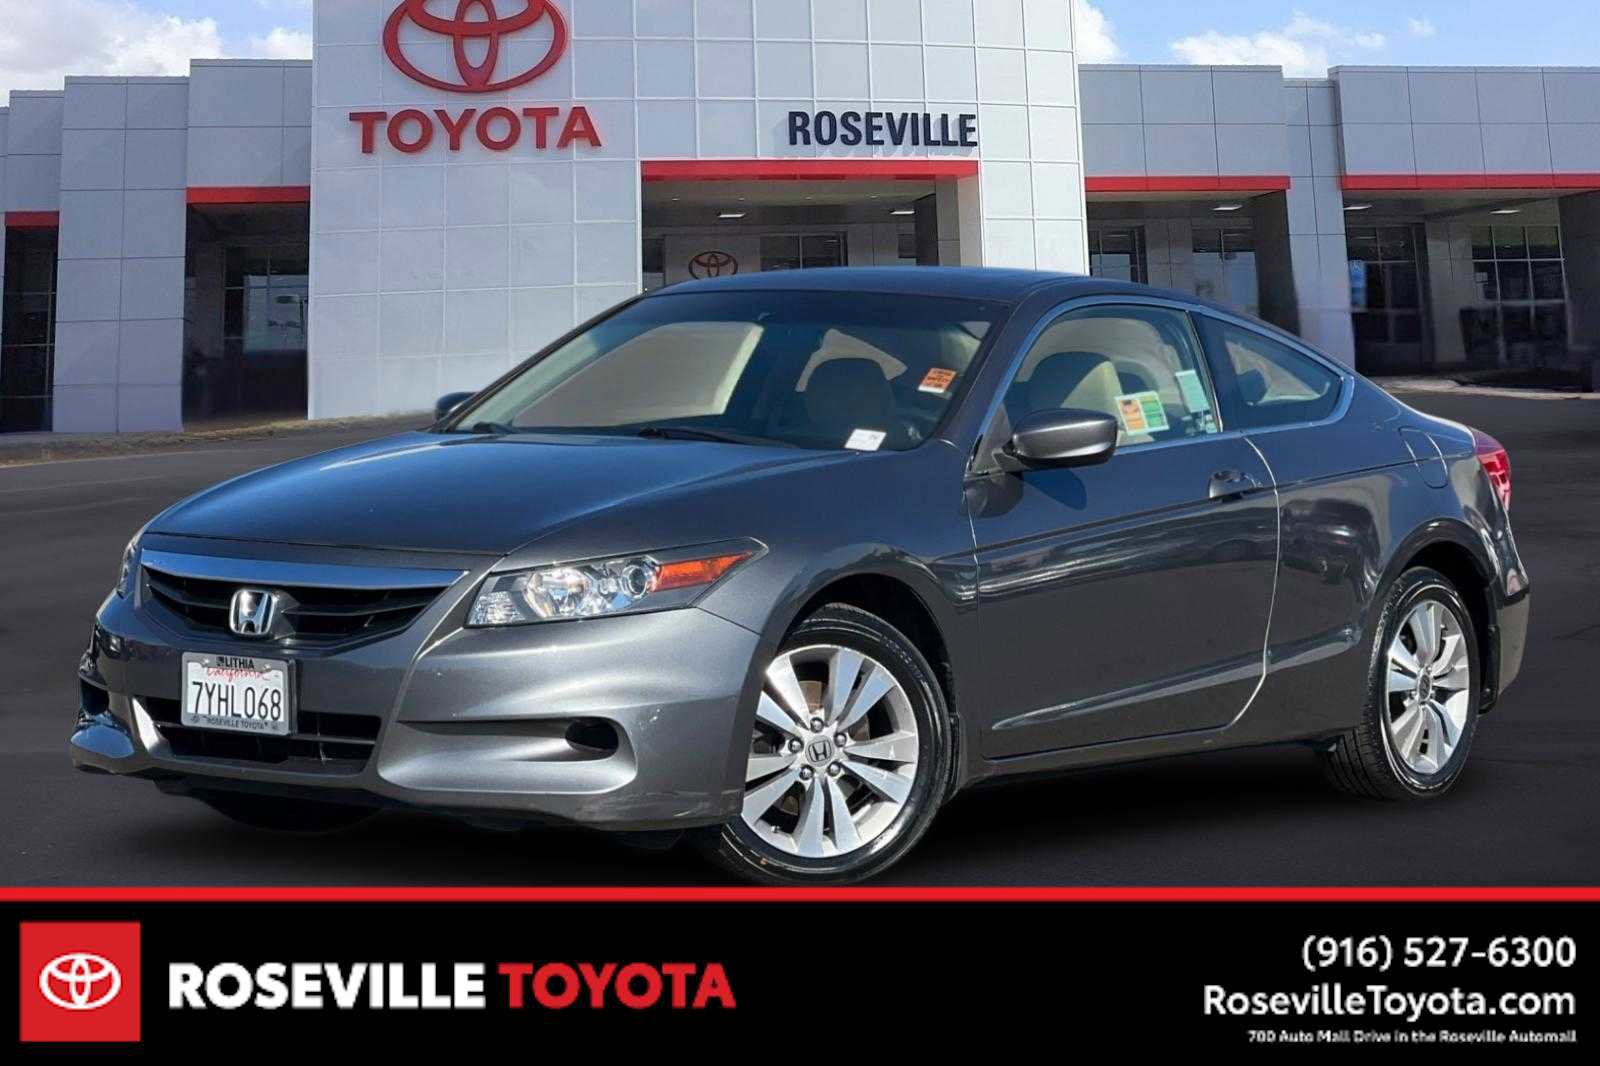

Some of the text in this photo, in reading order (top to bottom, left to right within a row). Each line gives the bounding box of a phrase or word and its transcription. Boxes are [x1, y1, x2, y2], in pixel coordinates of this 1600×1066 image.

[349, 106, 602, 154] TOYOTA
[788, 111, 978, 147] ROSEVILLE
[225, 657, 255, 669] LITHIA
[192, 681, 282, 722] 7YHL068
